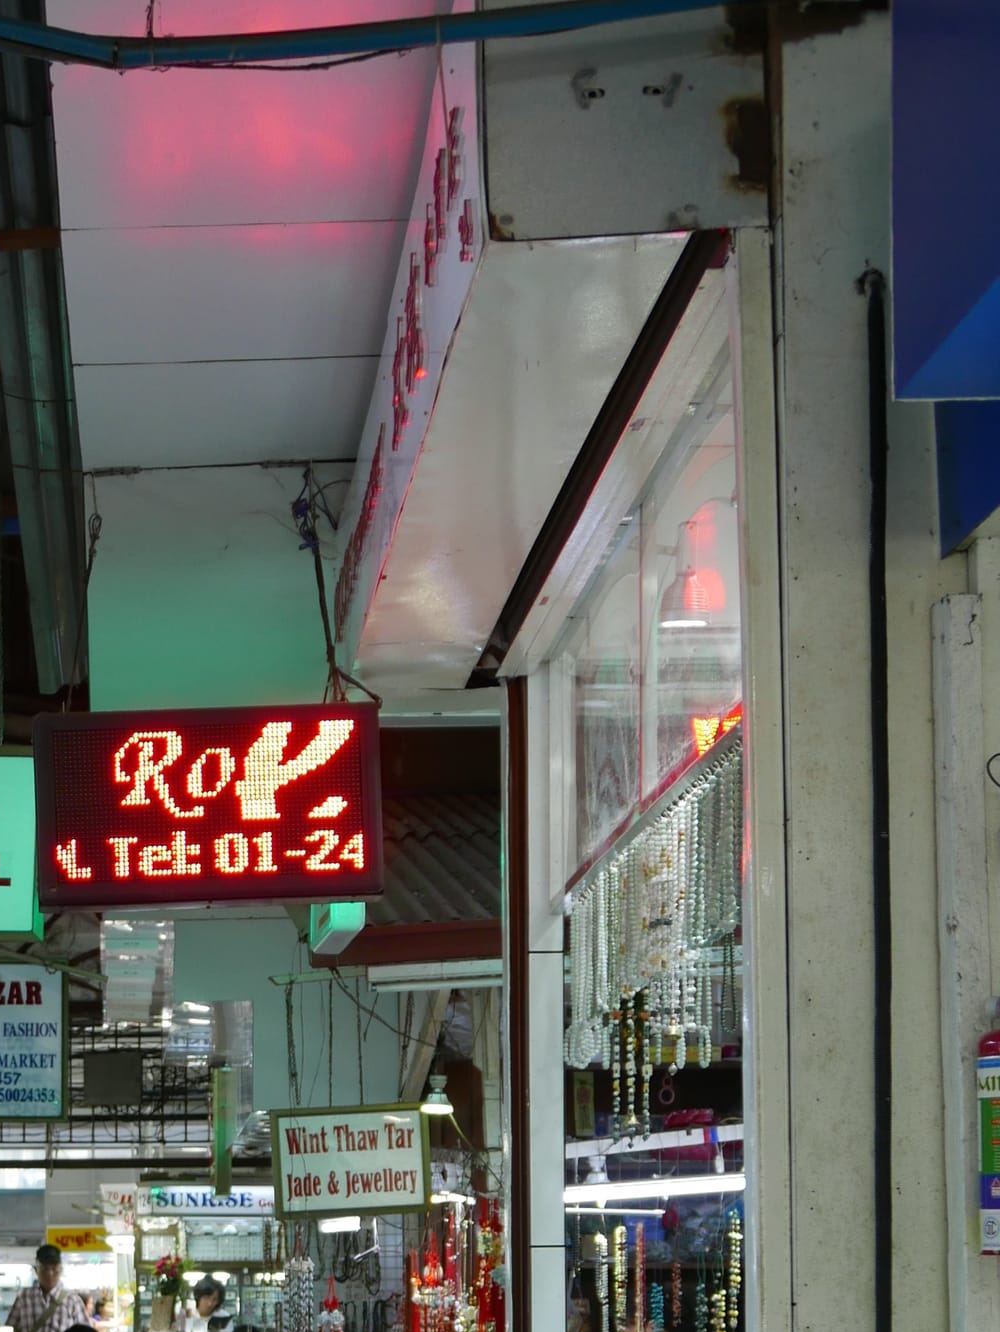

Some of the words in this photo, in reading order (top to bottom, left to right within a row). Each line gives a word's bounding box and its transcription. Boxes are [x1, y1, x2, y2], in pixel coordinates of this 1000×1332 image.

[2, 1022, 58, 1038] FASHION
[285, 1126, 329, 1155] Wint
[333, 1124, 379, 1153] Thaw
[384, 1122, 415, 1150] Tar
[286, 1172, 322, 1202] Jade
[327, 1170, 340, 1195] &
[345, 1168, 418, 1198] Jewellery
[156, 1191, 254, 1208] SUNRSE
